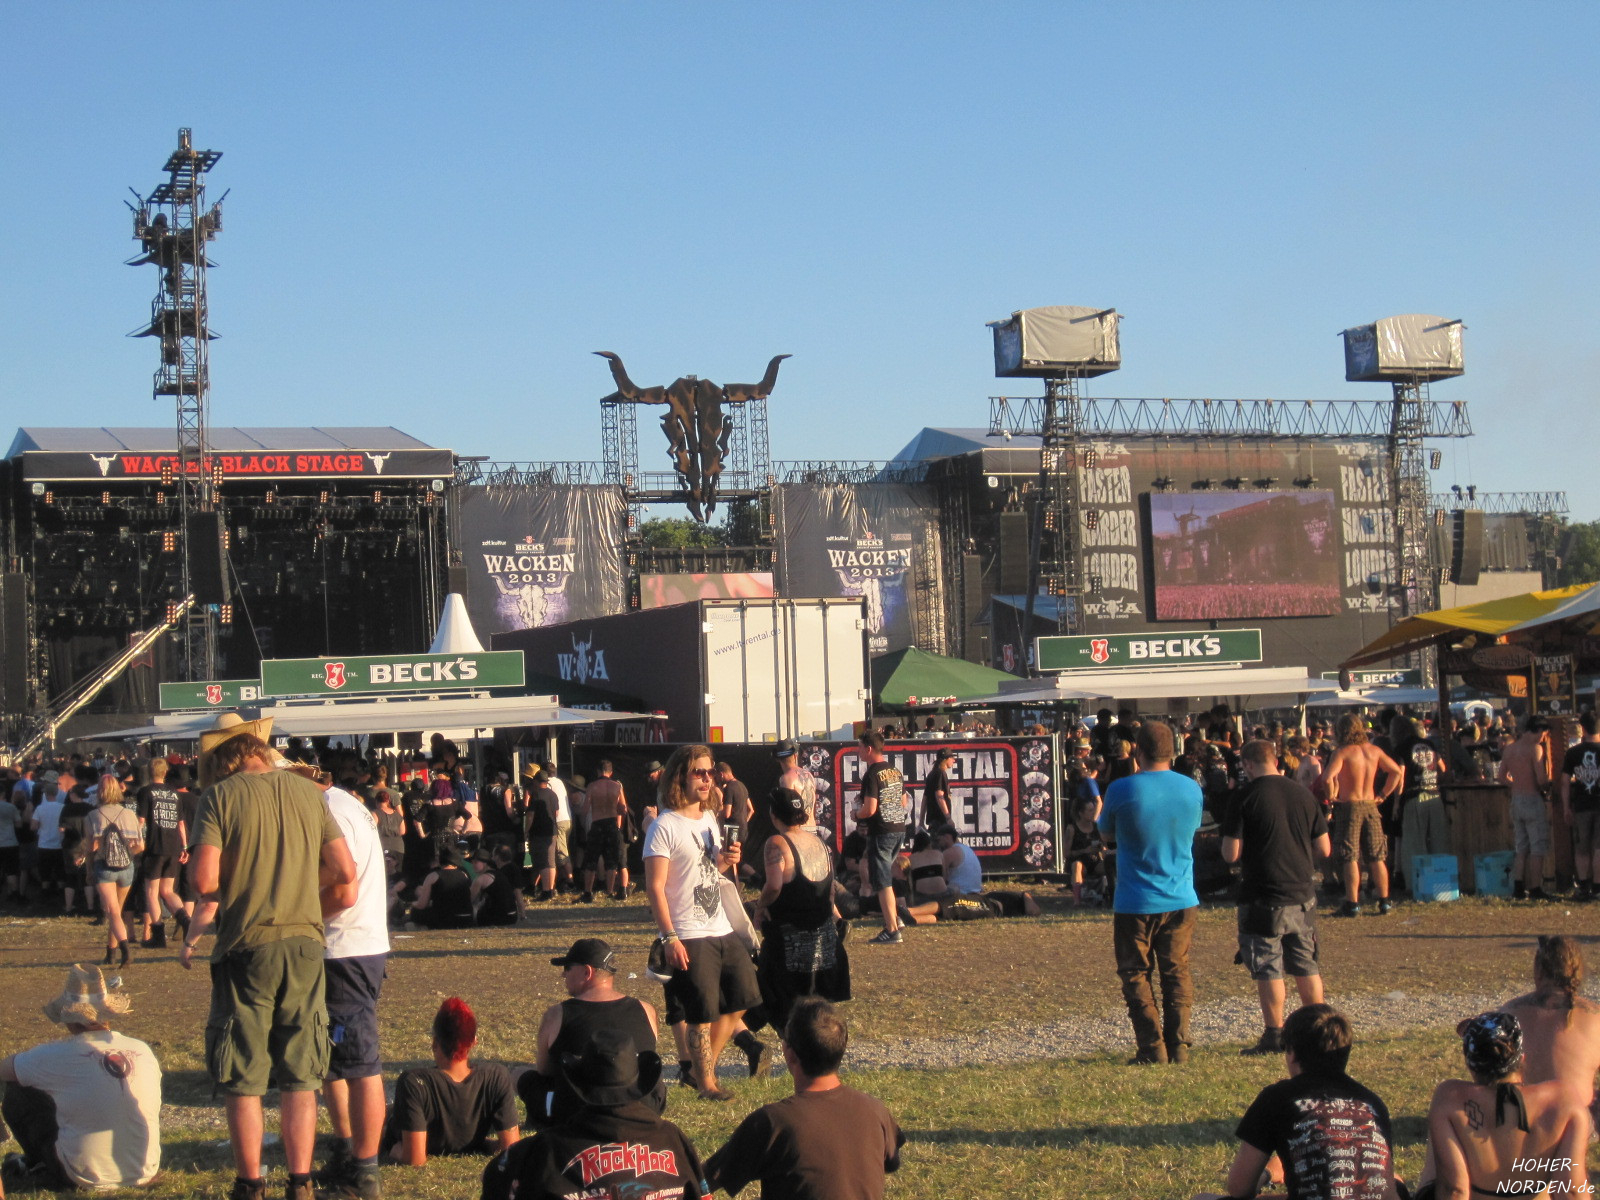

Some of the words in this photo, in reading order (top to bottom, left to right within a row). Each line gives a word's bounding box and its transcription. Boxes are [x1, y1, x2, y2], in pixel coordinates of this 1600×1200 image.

[220, 456, 290, 472] BLACK
[296, 455, 363, 472] STAGE
[483, 553, 575, 573] WACKEN
[827, 548, 912, 568] WACKEN
[509, 573, 556, 583] 2013
[851, 568, 894, 577] 2013
[1129, 634, 1221, 659] BECK'S
[1535, 655, 1571, 666] WACKEN
[369, 657, 478, 684] BECK'S
[1362, 671, 1404, 684] BECK'S
